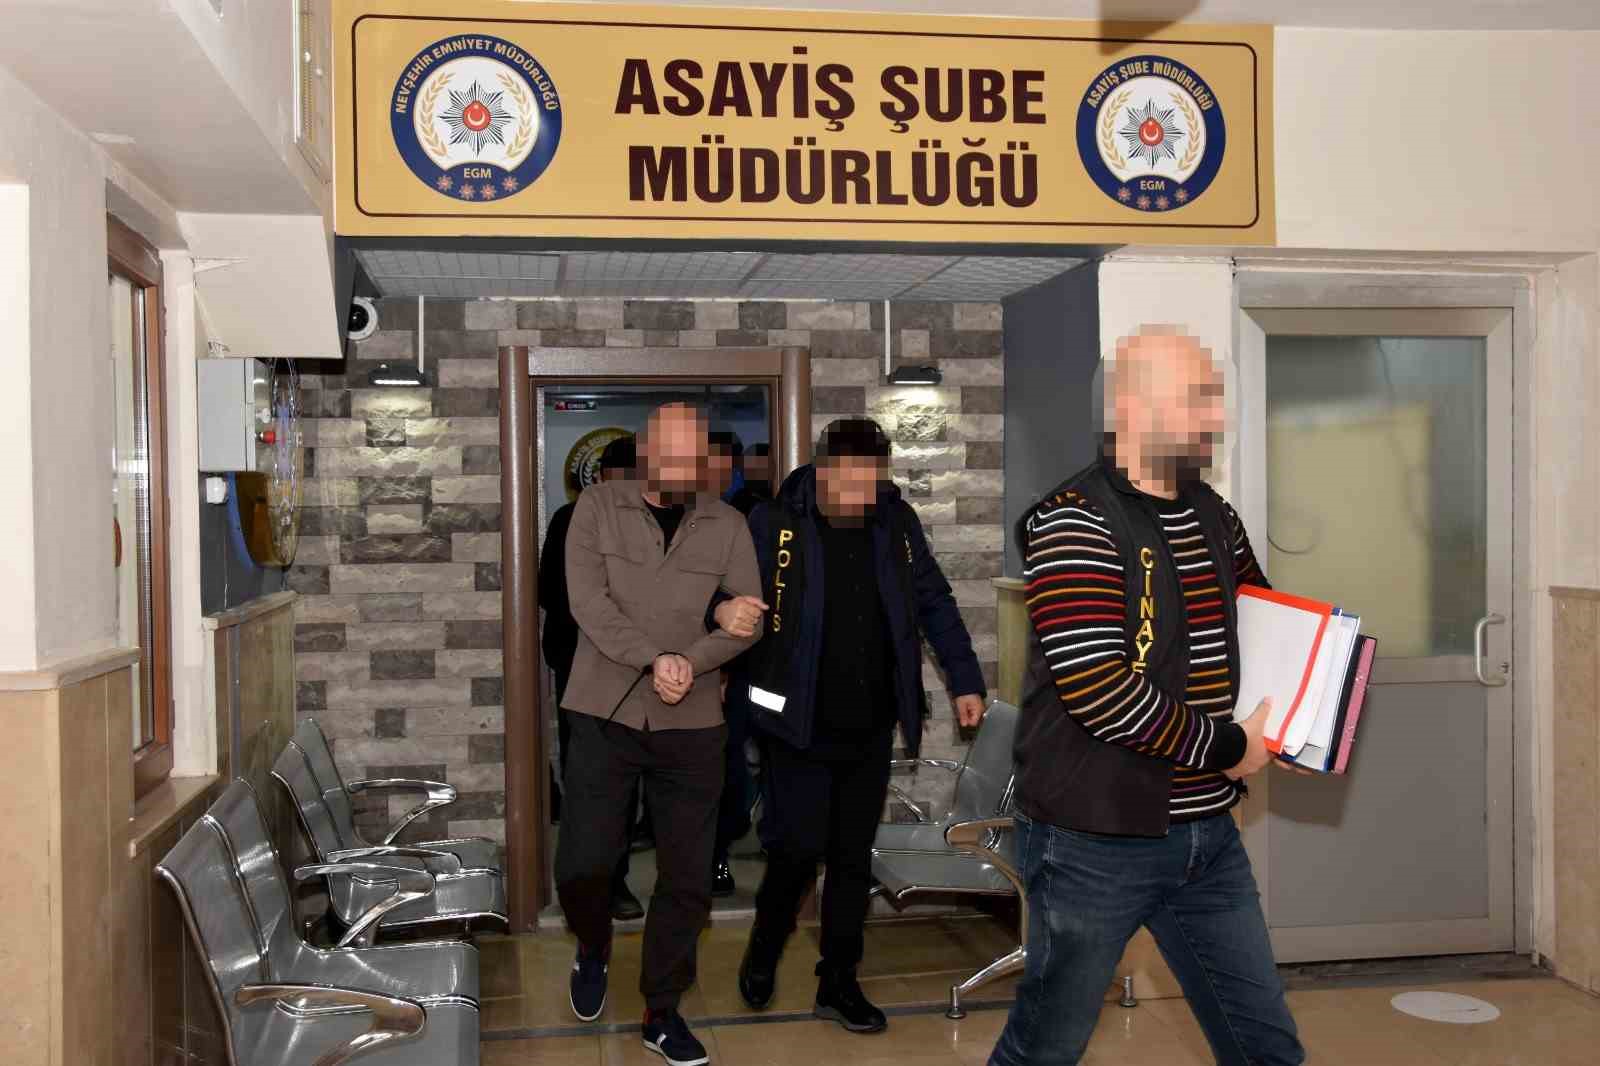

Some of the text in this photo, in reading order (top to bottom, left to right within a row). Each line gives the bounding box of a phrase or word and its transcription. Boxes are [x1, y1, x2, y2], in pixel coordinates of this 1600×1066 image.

[395, 37, 560, 113] NEVŞEHİR EMNİYET MÜDÜRLÜĞÜ
[614, 46, 1047, 134] ASAYİŞ ŞUBE
[1087, 61, 1214, 111] ASAYİŞ ŞUBE MÜDÜRLÜĞÜ
[463, 168, 492, 179] EGM
[628, 134, 1038, 208] MÜDÜRLÜĞÜ
[1140, 180, 1165, 191] EGM
